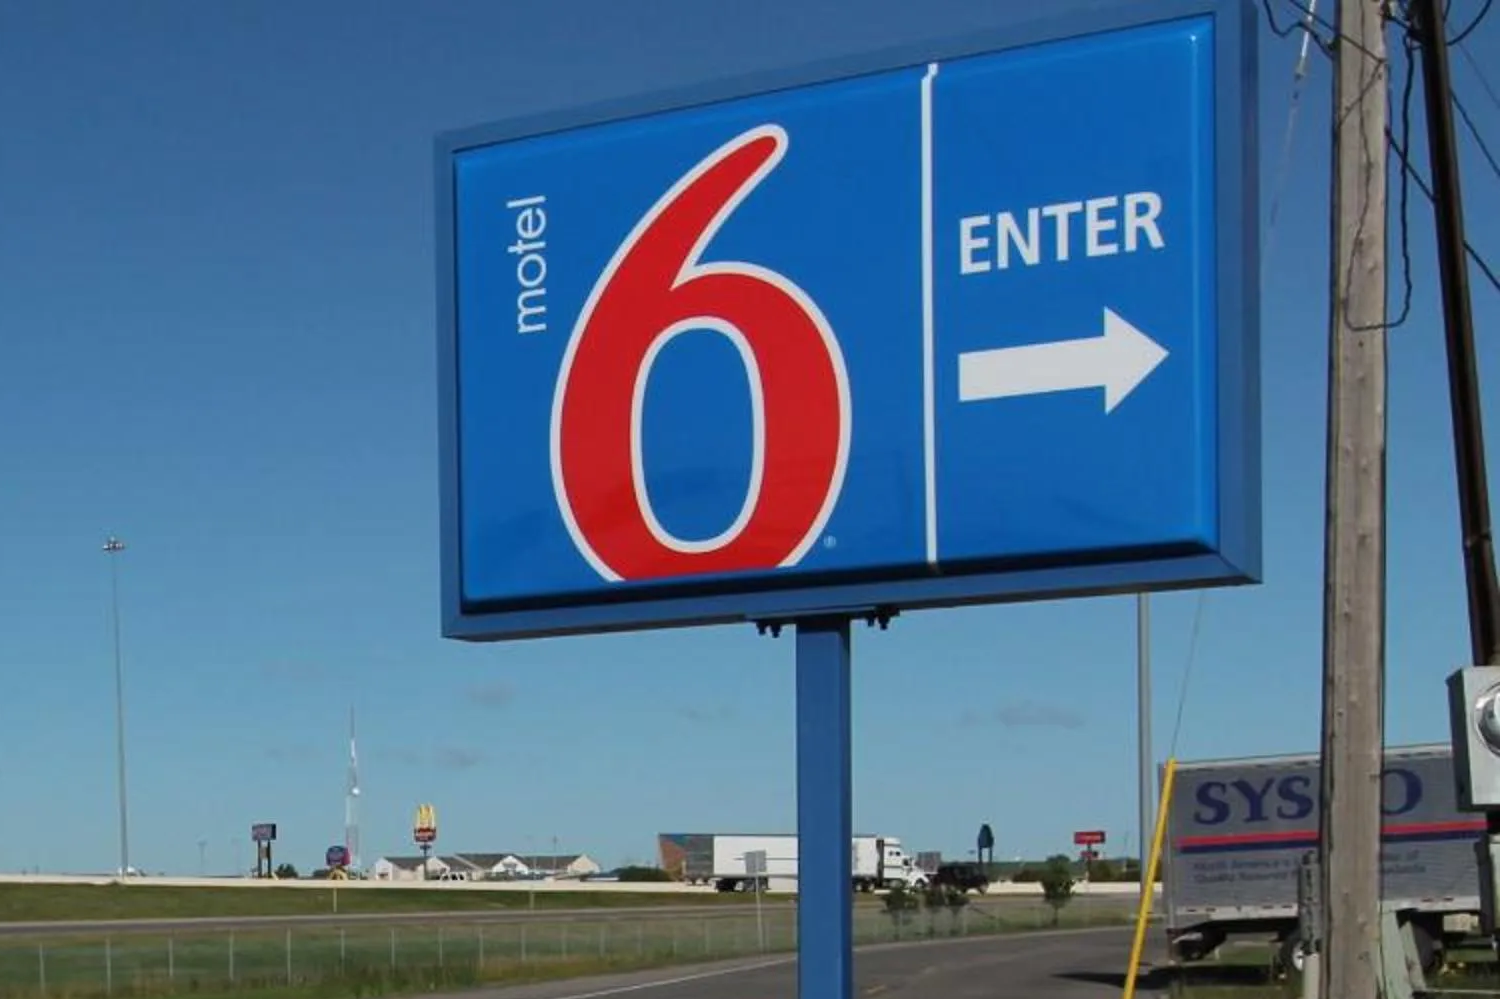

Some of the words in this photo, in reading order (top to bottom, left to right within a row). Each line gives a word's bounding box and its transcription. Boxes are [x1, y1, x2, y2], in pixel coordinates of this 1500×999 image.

[507, 195, 547, 333] motel
[960, 191, 1164, 274] ENTER
[549, 124, 852, 582] 6
[1193, 768, 1423, 825] SYSO
